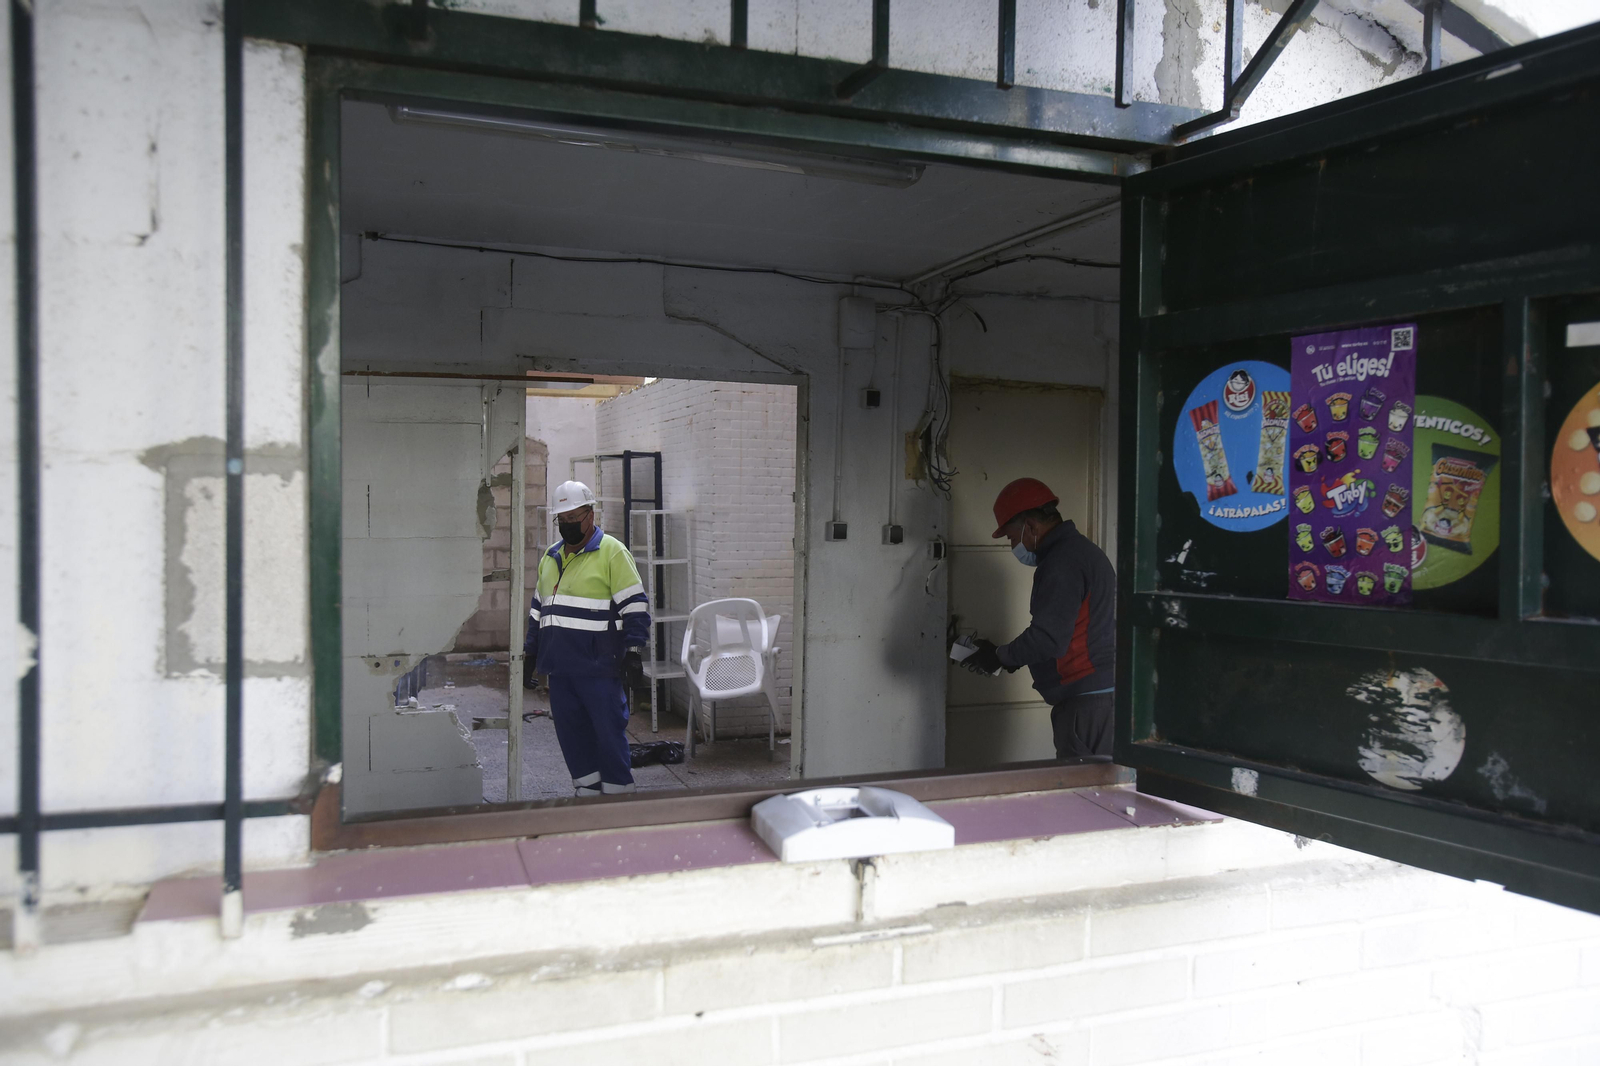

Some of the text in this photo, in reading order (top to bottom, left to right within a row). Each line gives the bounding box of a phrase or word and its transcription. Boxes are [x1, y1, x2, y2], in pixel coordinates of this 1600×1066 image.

[1311, 363, 1333, 382] Tú
[1336, 352, 1395, 381] eliges!
[1208, 498, 1286, 518] ¡ATRÁPALAS!
